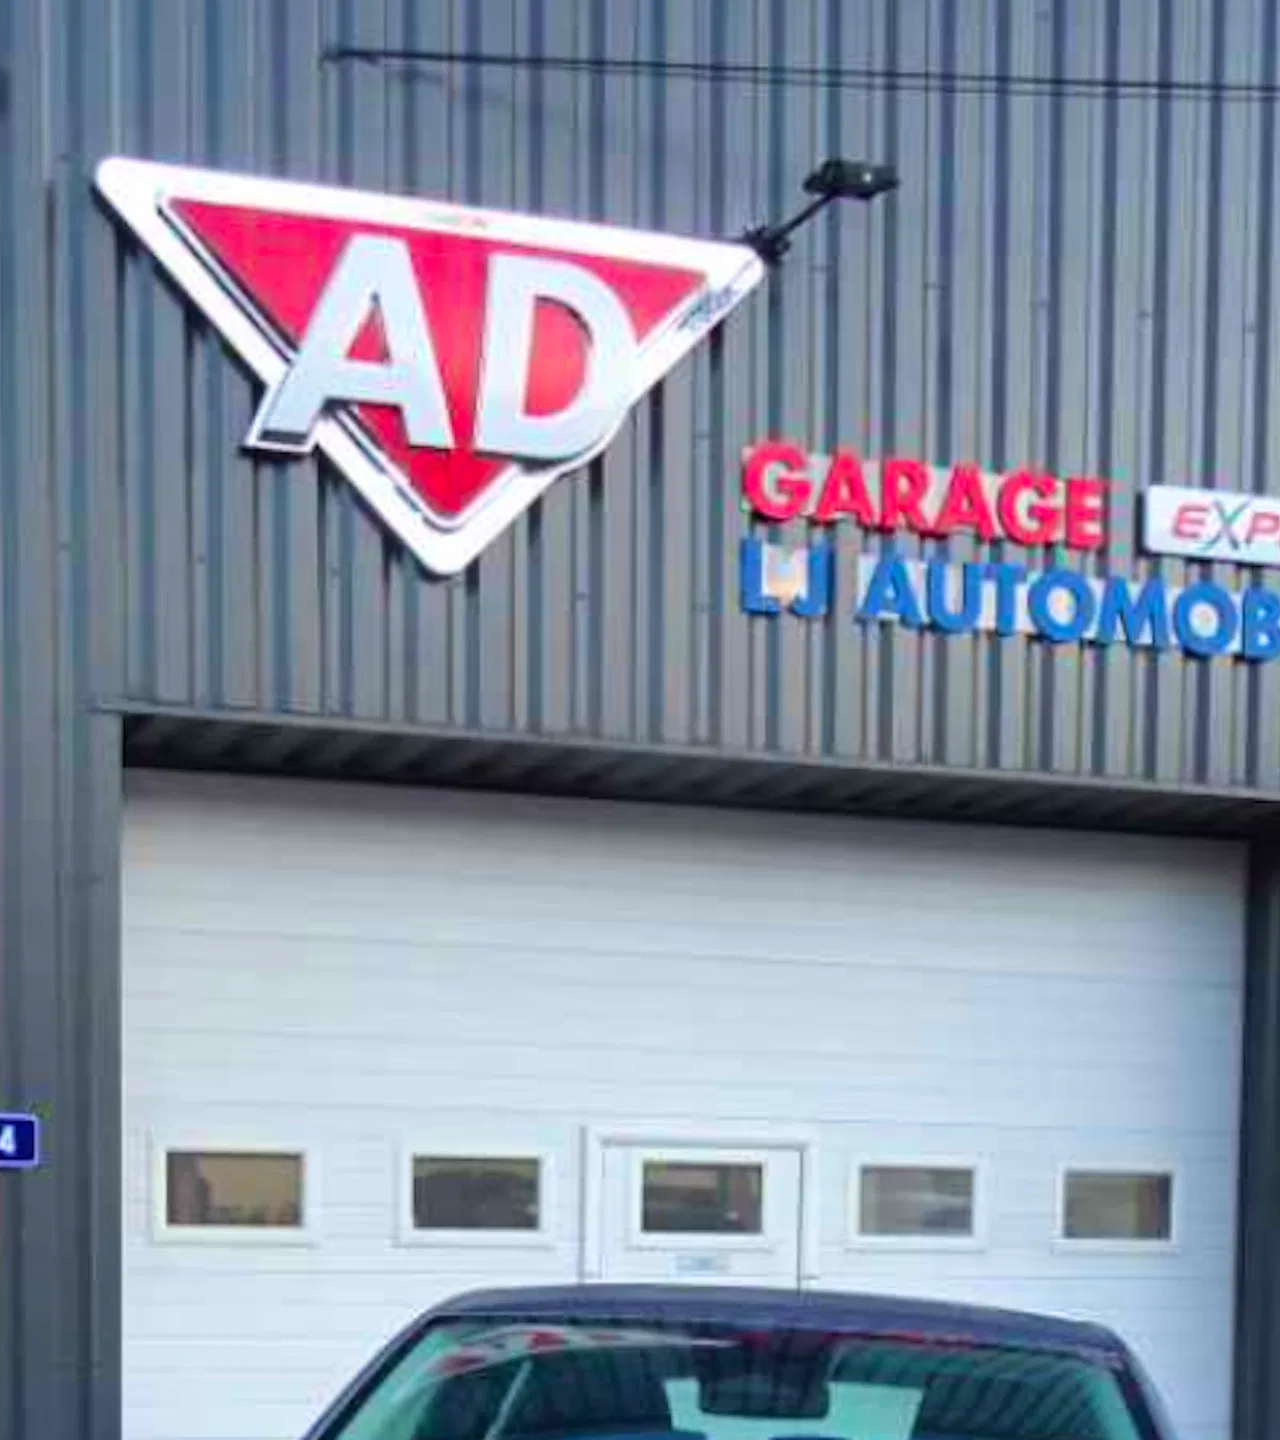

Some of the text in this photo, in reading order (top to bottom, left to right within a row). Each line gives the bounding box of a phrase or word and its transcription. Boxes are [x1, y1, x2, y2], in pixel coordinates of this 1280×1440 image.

[246, 232, 641, 466] AD
[740, 440, 1113, 550] GARAGE
[739, 536, 835, 618] LJ
